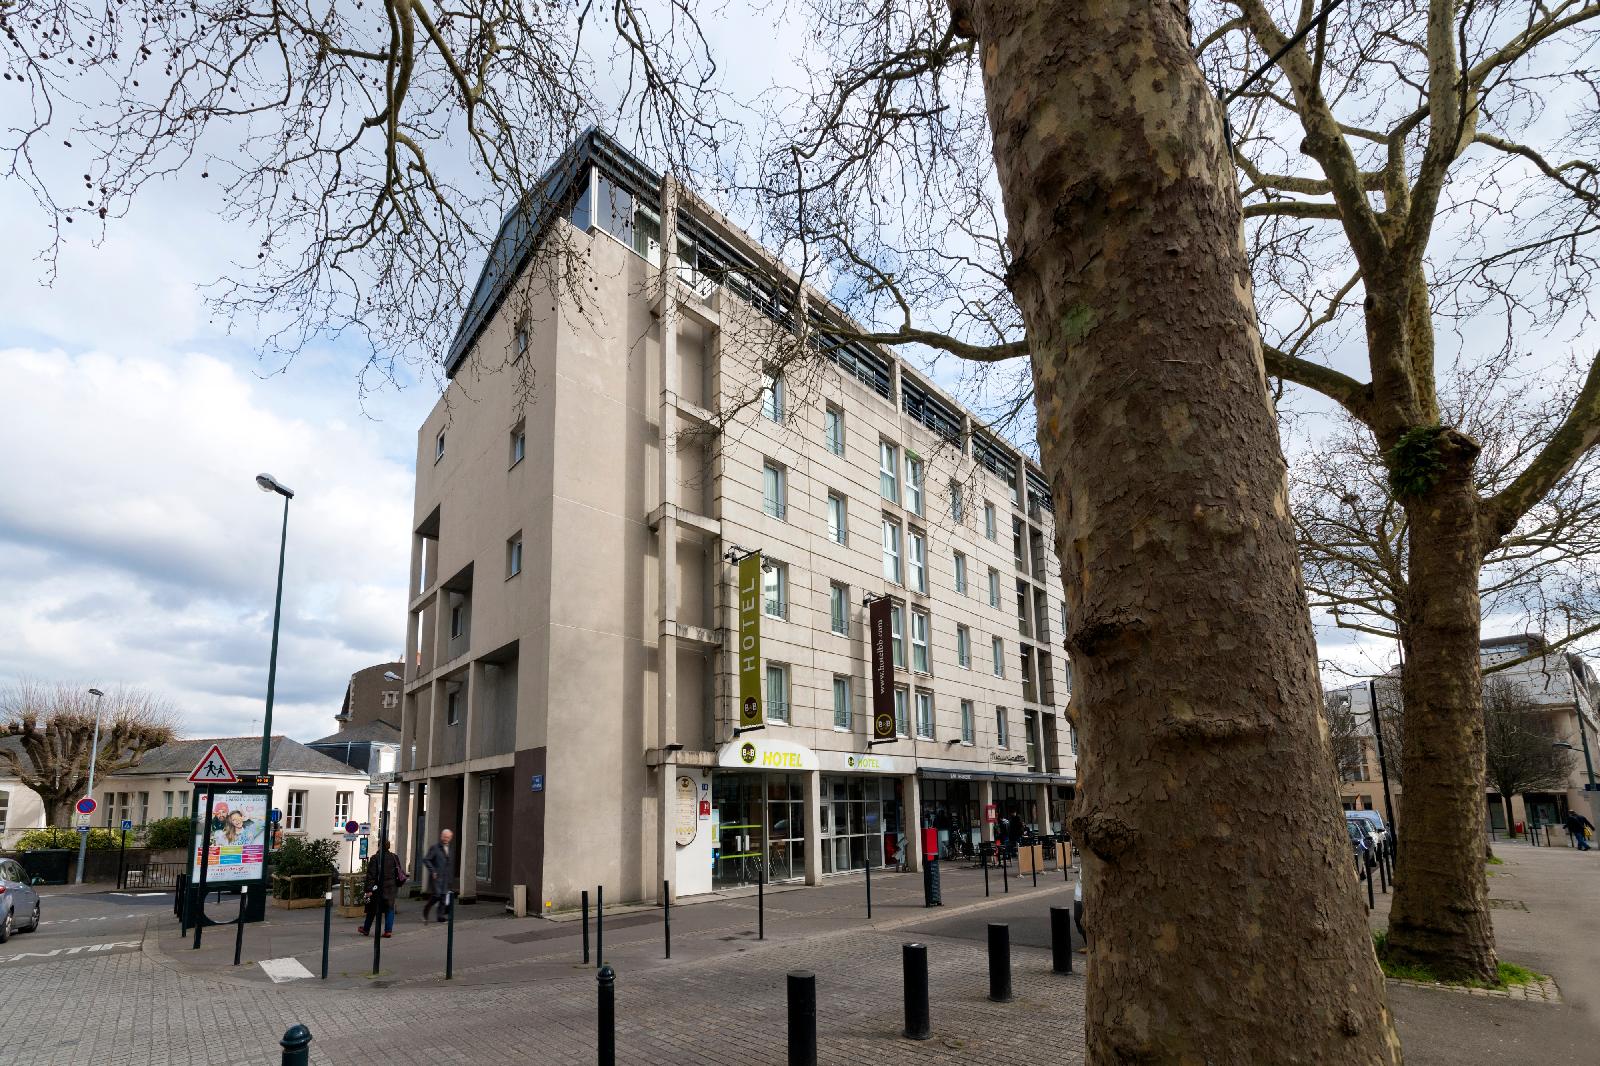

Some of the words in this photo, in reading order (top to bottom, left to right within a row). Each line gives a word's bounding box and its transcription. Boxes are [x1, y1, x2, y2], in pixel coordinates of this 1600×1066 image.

[742, 577, 756, 672] HOTEL
[876, 619, 885, 695] www.hotelbb.com
[763, 751, 802, 767] HOTEL
[857, 758, 880, 768] HOTEL
